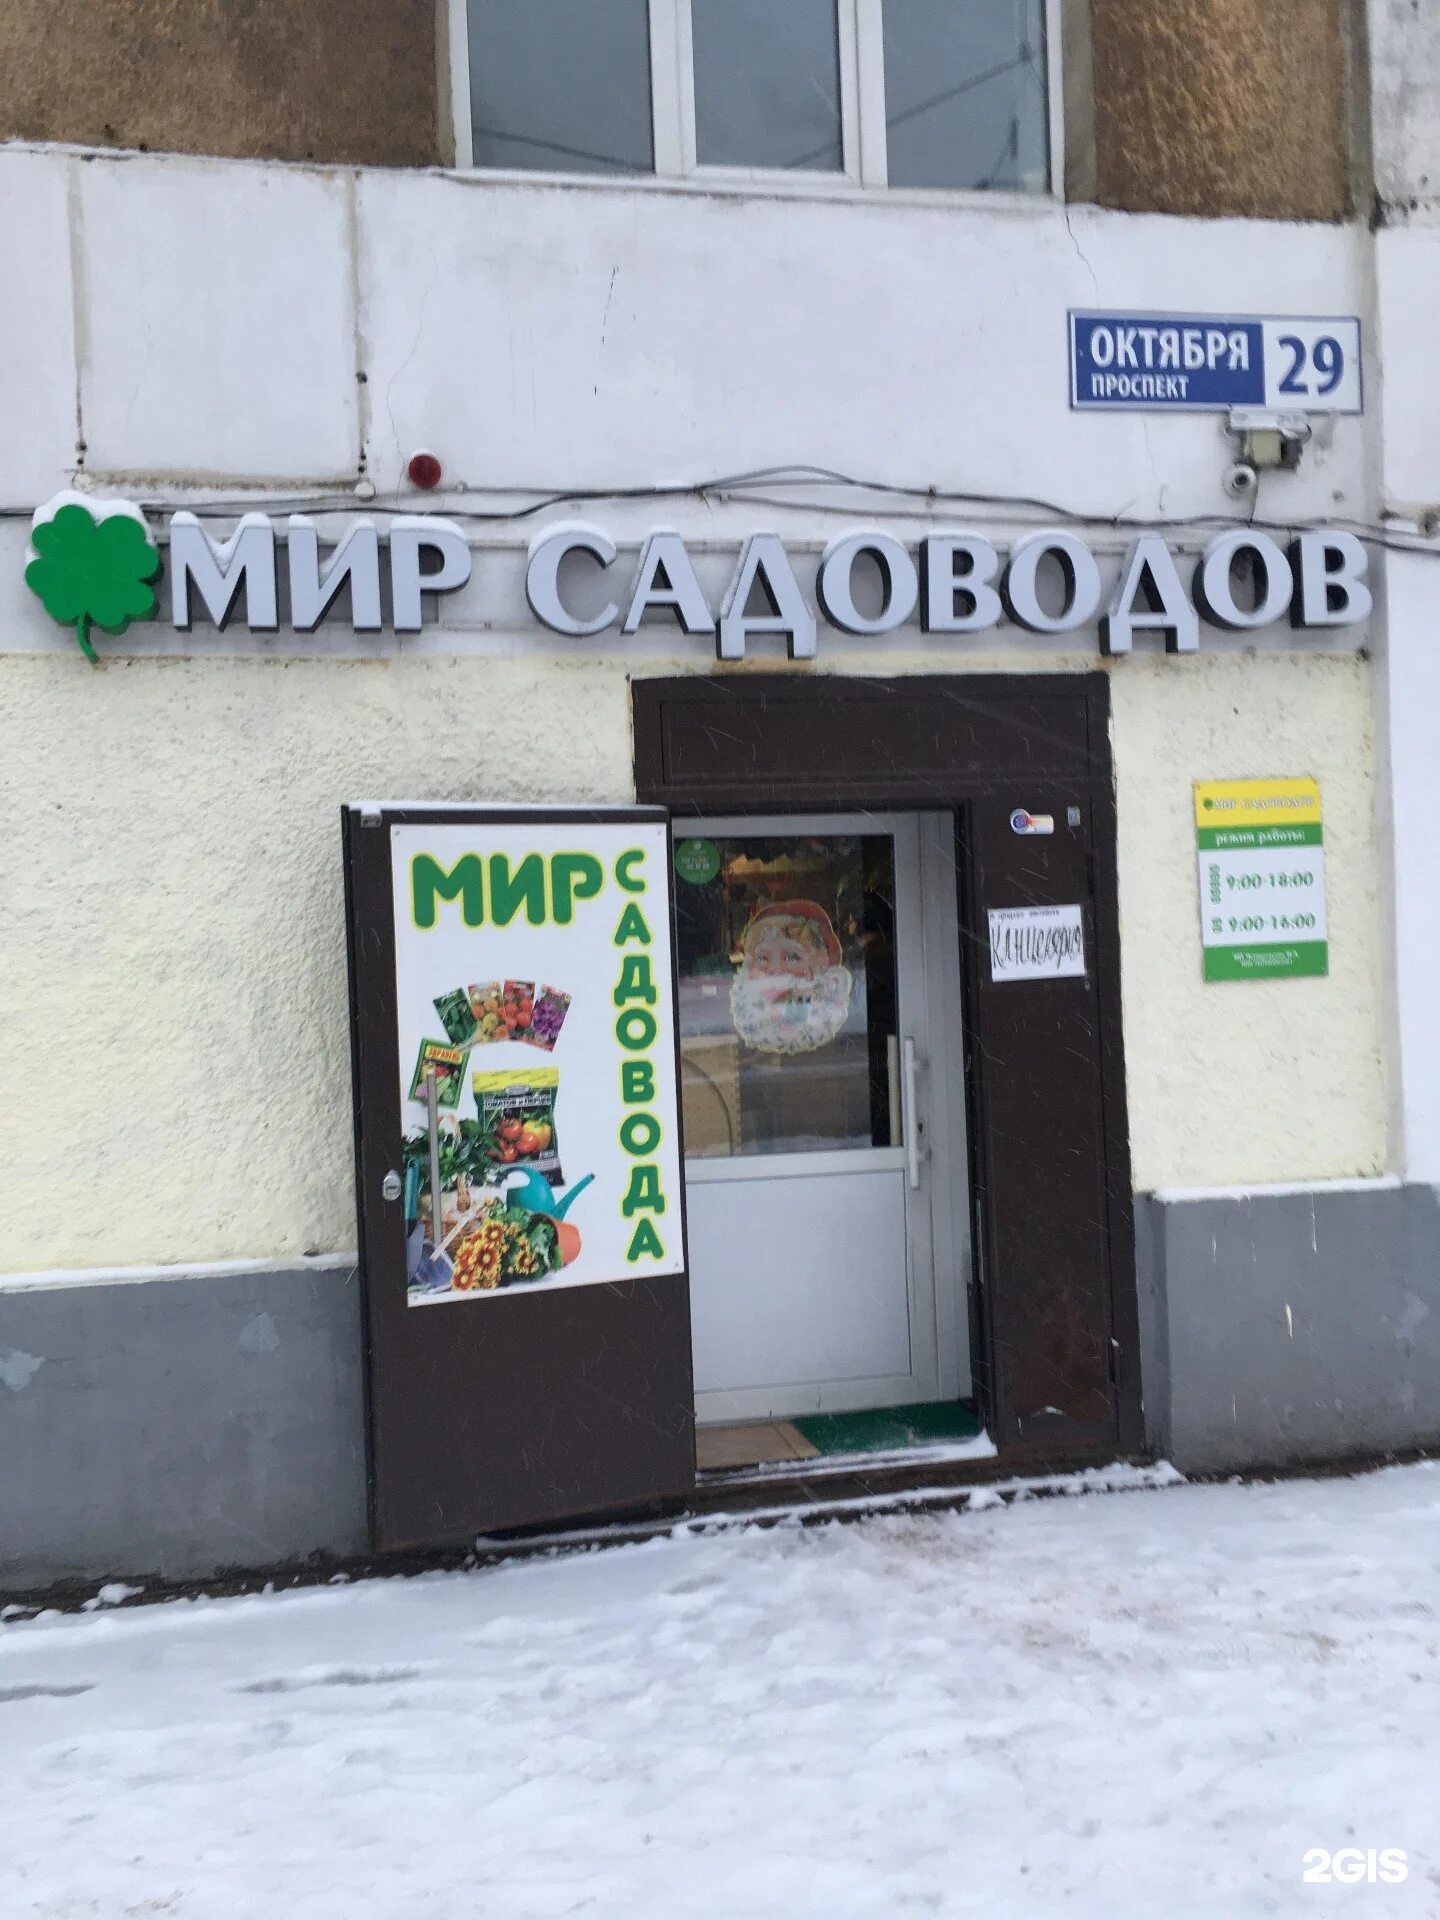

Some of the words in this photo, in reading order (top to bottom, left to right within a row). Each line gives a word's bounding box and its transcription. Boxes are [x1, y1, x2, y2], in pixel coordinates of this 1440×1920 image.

[1090, 325, 1250, 371] ОКТЯБРЯ
[1278, 334, 1345, 397] 29
[1090, 373, 1190, 399] ПРОСПЕКТ
[168, 514, 472, 632] МИР
[525, 526, 1373, 661] САДОВОДОВ
[410, 848, 606, 929] МИР
[612, 847, 668, 1265] САДОВОДА
